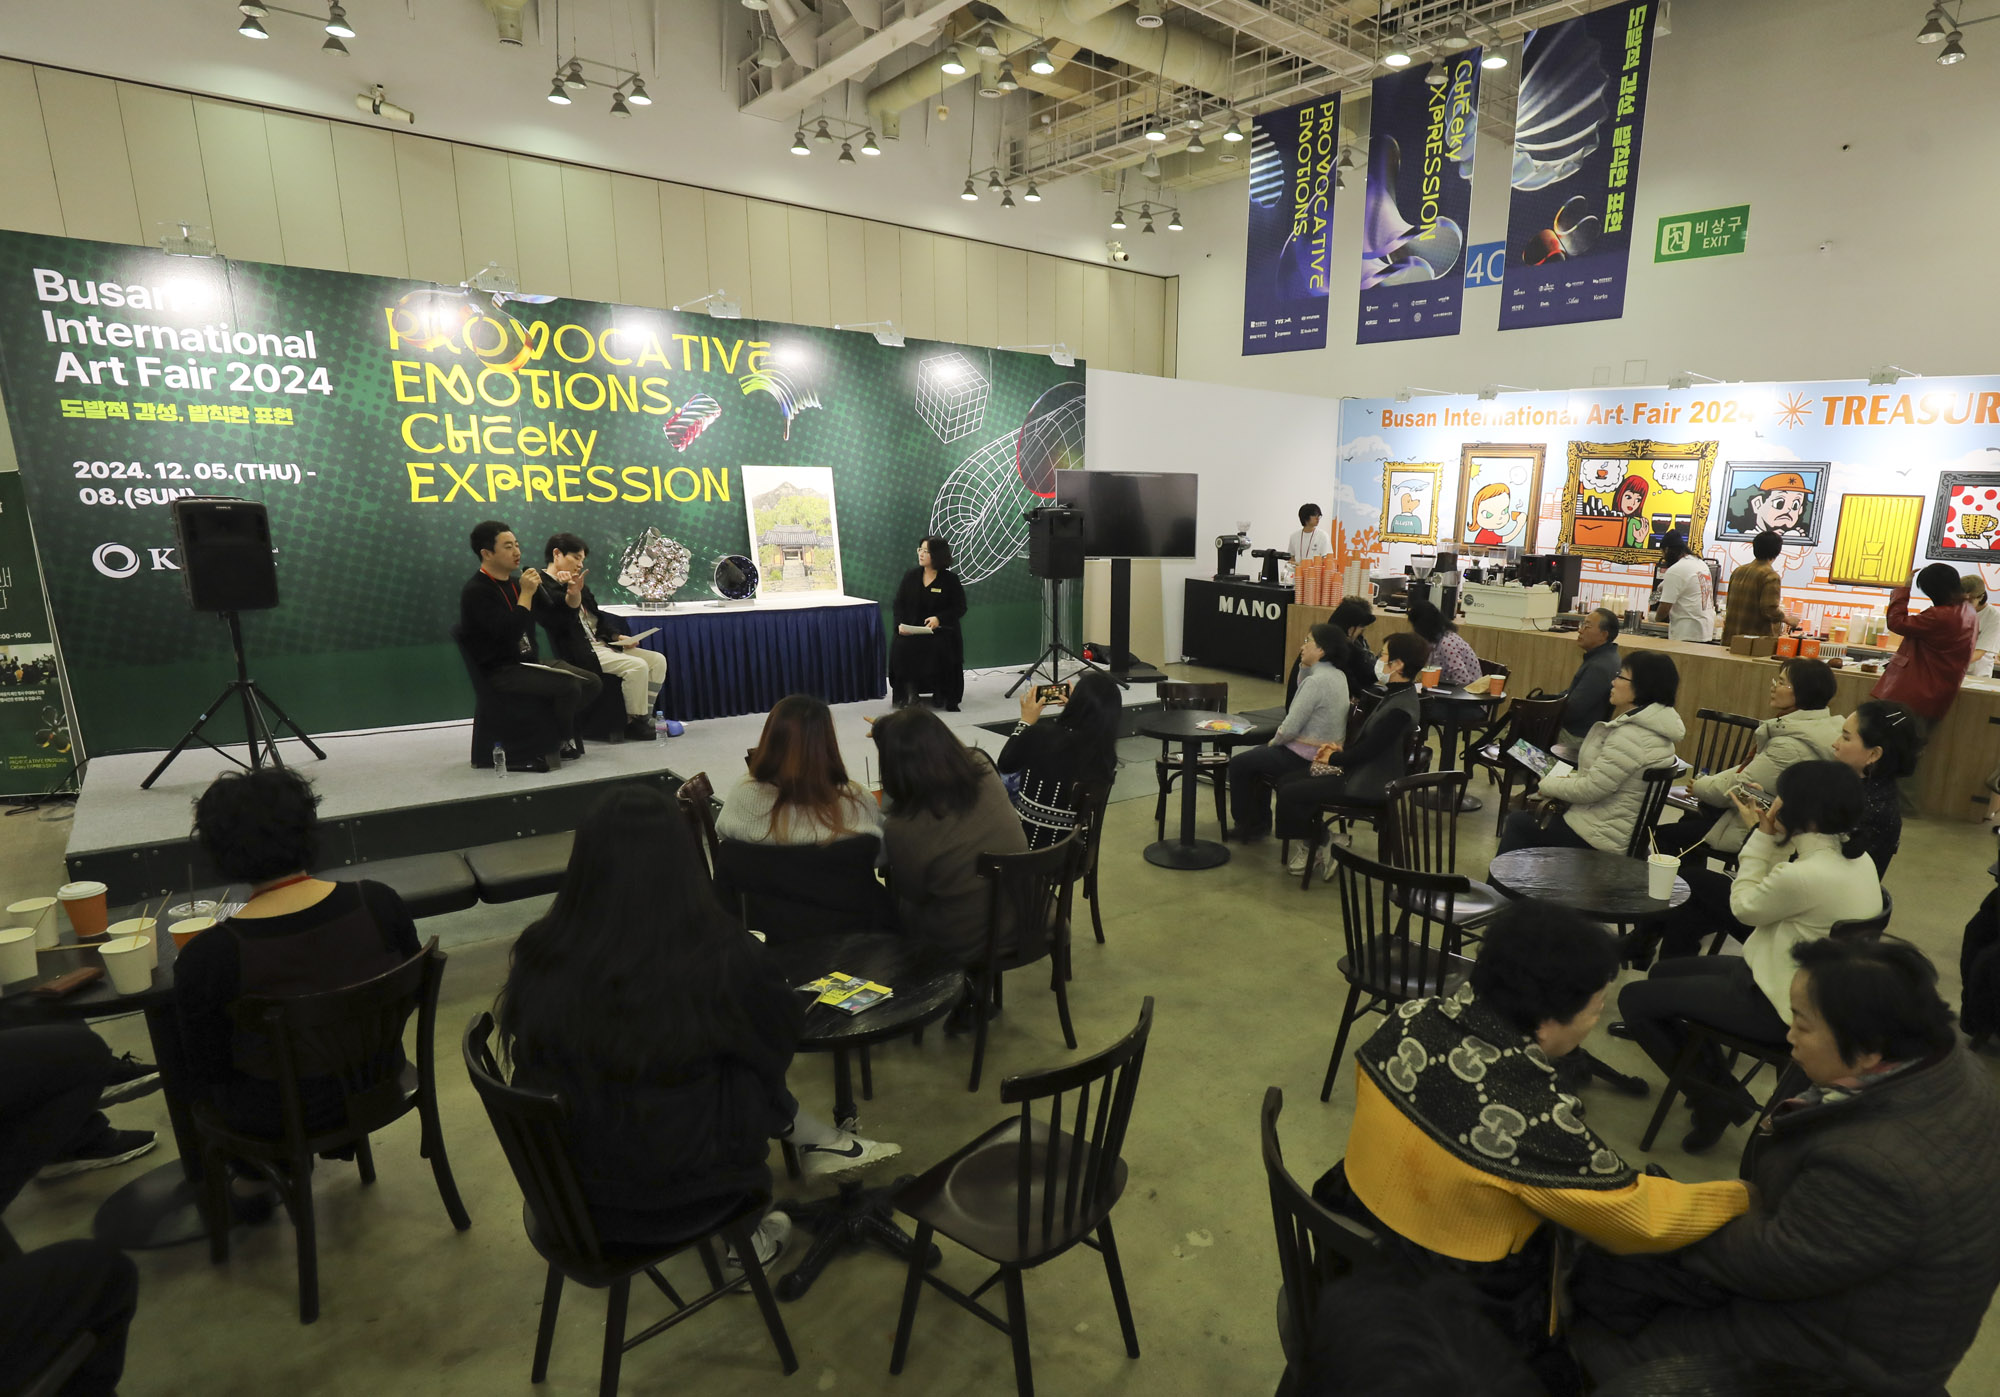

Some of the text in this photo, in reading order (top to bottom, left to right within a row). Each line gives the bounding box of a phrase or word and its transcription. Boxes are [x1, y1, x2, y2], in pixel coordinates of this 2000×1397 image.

[1622, 4, 1648, 71] 도발적
[1419, 66, 1448, 241] XPRESSION
[1608, 125, 1633, 188] 발칙한
[1310, 101, 1335, 289] PROVOCATIVE
[1603, 191, 1625, 233] 표현
[1695, 216, 1742, 236] 비상구
[1702, 235, 1731, 249] EXIT
[42, 310, 317, 359] International
[54, 351, 334, 396] Art Fair 2024
[60, 399, 131, 421] 도발적
[187, 404, 250, 425] 발칙한
[253, 407, 295, 426] 표현
[1381, 409, 1437, 428] Busan
[1586, 403, 1625, 425] Art
[1632, 402, 1682, 425] Fair
[405, 462, 732, 504] EXPRESSION
[1218, 595, 1282, 621] MANO
